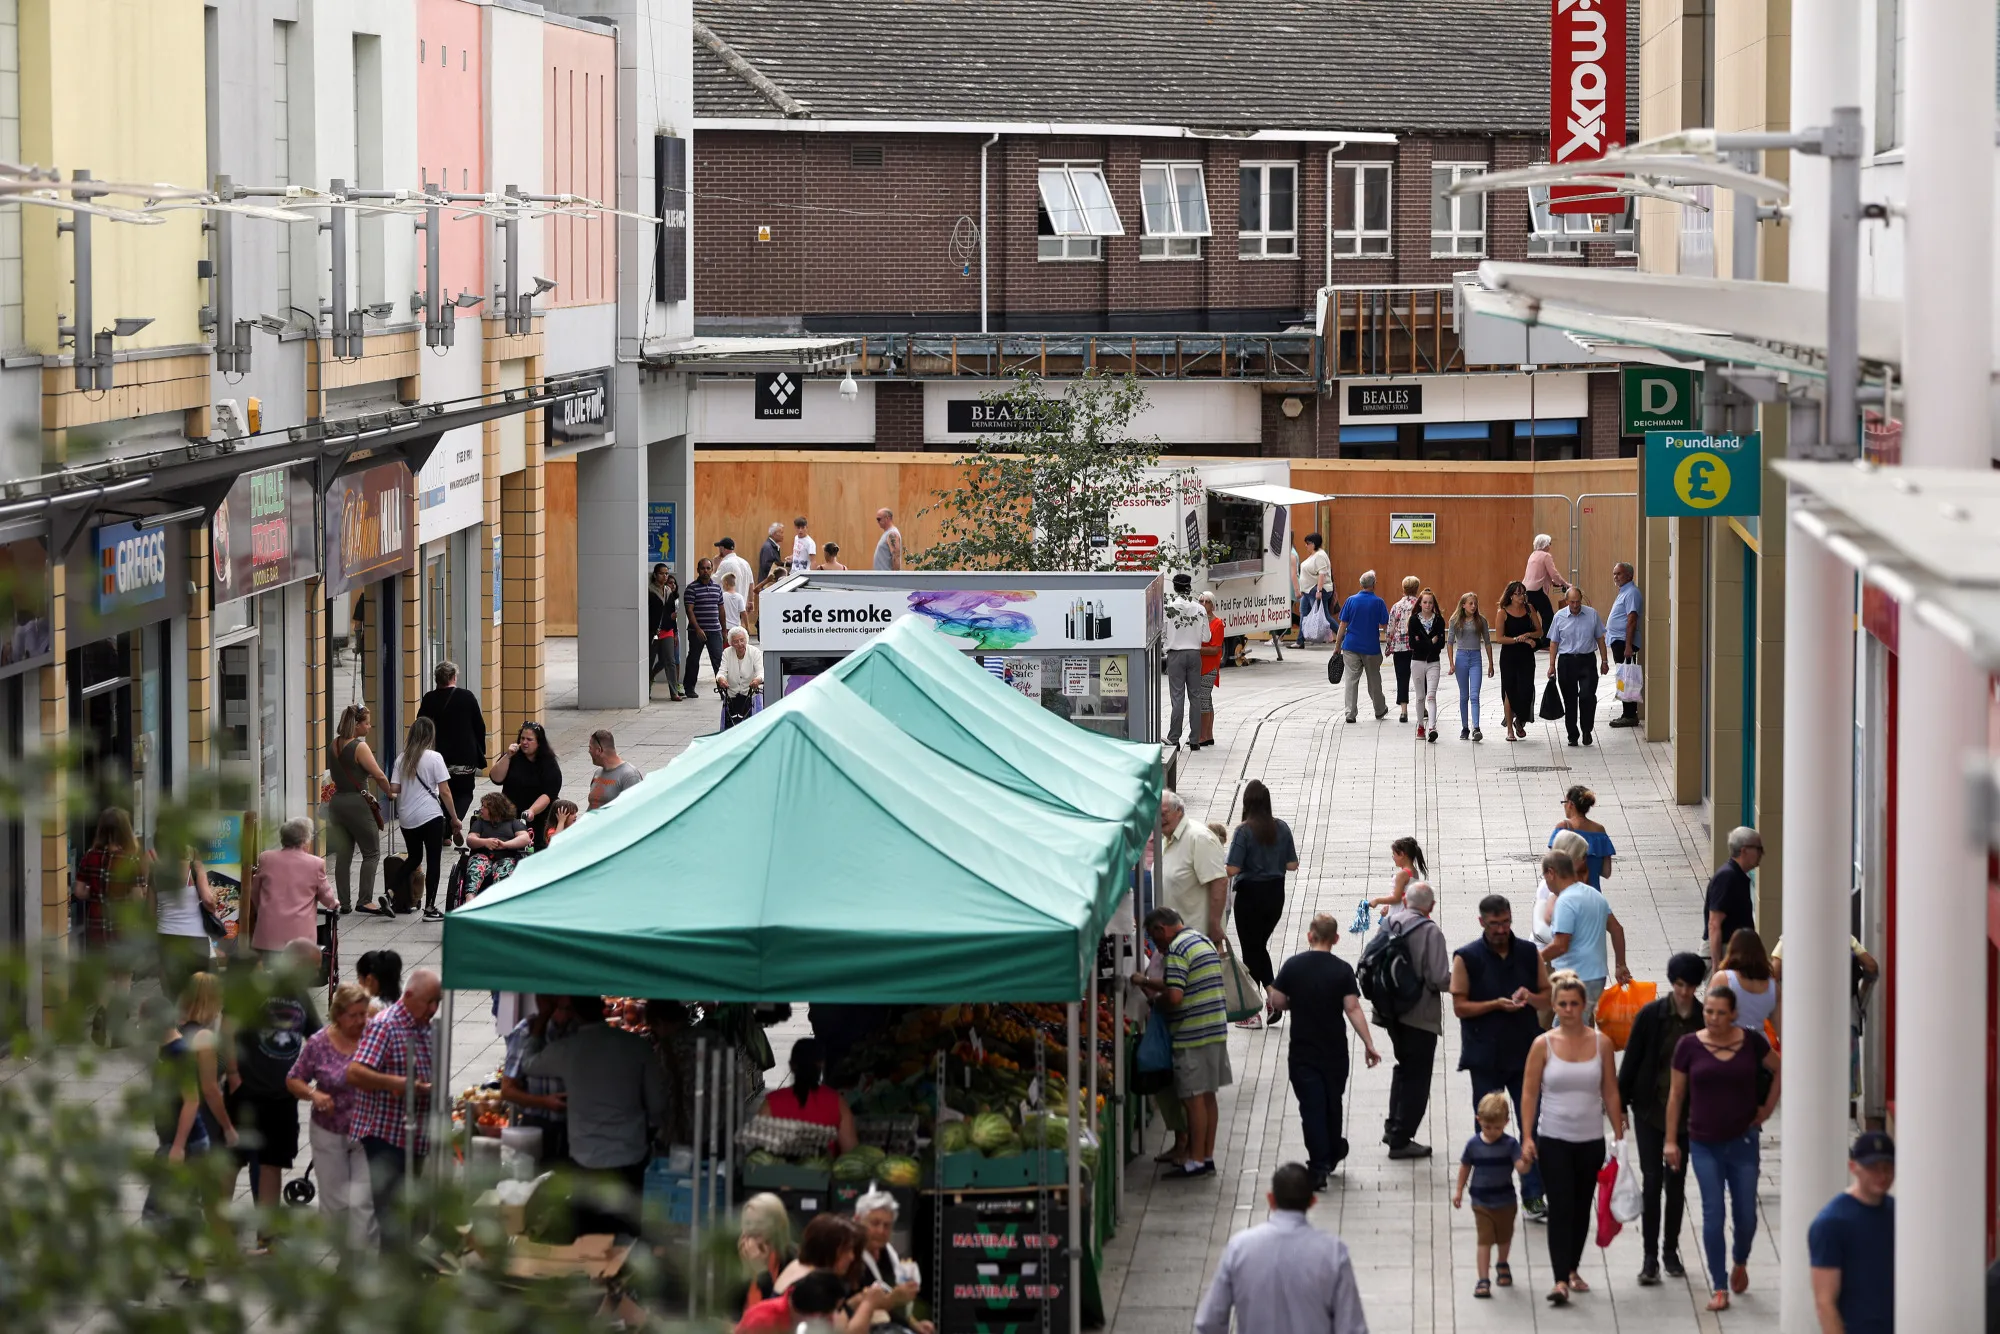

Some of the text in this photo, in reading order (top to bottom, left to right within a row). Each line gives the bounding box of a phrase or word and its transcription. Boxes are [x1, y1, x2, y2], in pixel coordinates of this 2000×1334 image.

[1363, 390, 1409, 404] BEALES
[1641, 378, 1678, 415] D
[564, 396, 586, 426] BLUE
[1182, 476, 1202, 488] Mobile
[1183, 492, 1201, 505] Booth
[380, 487, 402, 556] HILL
[116, 530, 165, 594] GREGGS
[1220, 599, 1232, 611] Paid
[1233, 598, 1242, 610] For
[1244, 597, 1253, 608] Old
[1254, 595, 1267, 607] Used
[1268, 594, 1286, 605] Phones
[782, 604, 892, 623] safe smoke
[1228, 610, 1259, 628] Unlocking
[1260, 608, 1266, 623] &
[1267, 607, 1291, 625] Repairs
[782, 627, 817, 635] specialists
[1005, 662, 1040, 671] Smoke
[1012, 670, 1034, 678] Safe
[1013, 681, 1032, 691] Gift
[953, 1233, 1017, 1248] NATURAL
[954, 1284, 1019, 1299] NATURAL
